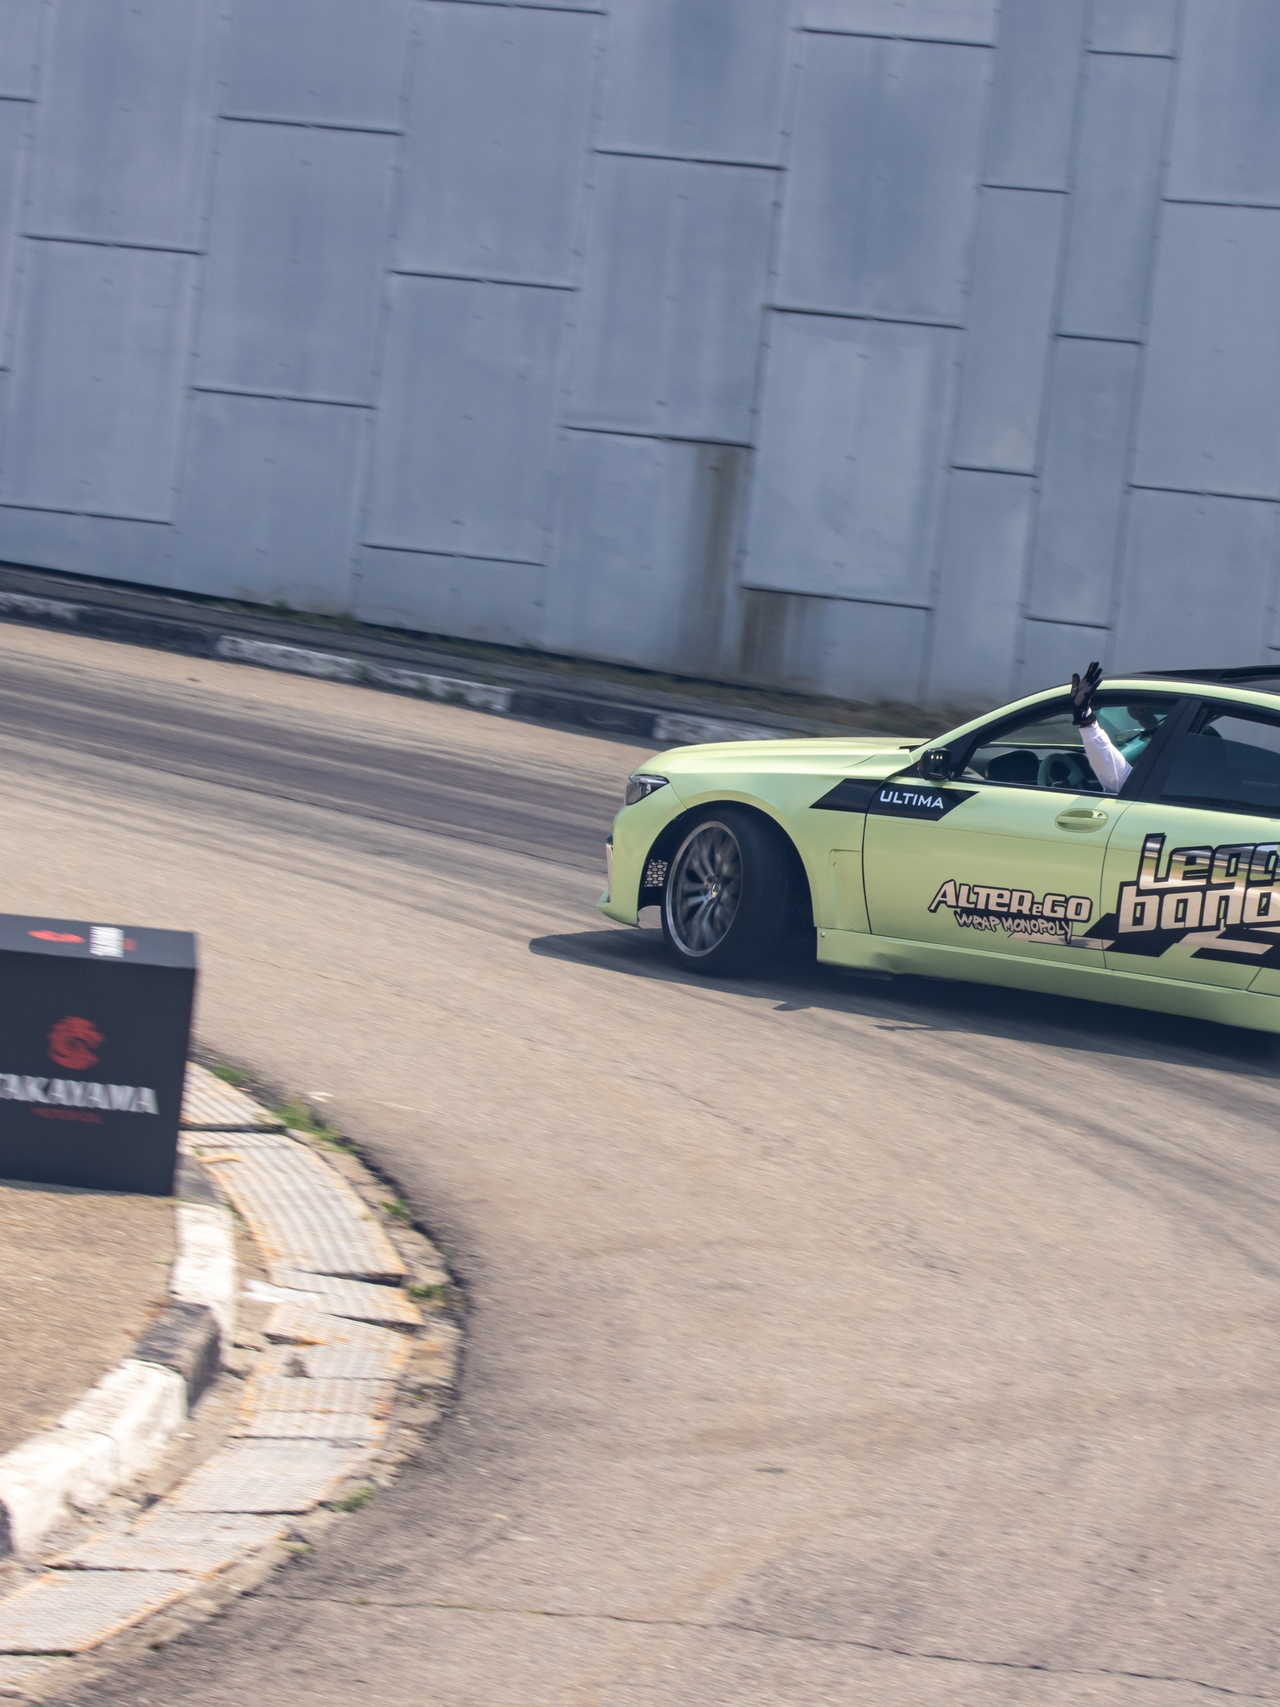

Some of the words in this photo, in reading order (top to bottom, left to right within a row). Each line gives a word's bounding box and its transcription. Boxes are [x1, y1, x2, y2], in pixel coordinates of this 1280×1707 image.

[880, 790, 944, 809] ULTIMA
[954, 910, 1001, 932] WRAP
[1001, 916, 1073, 944] MONOPOLY
